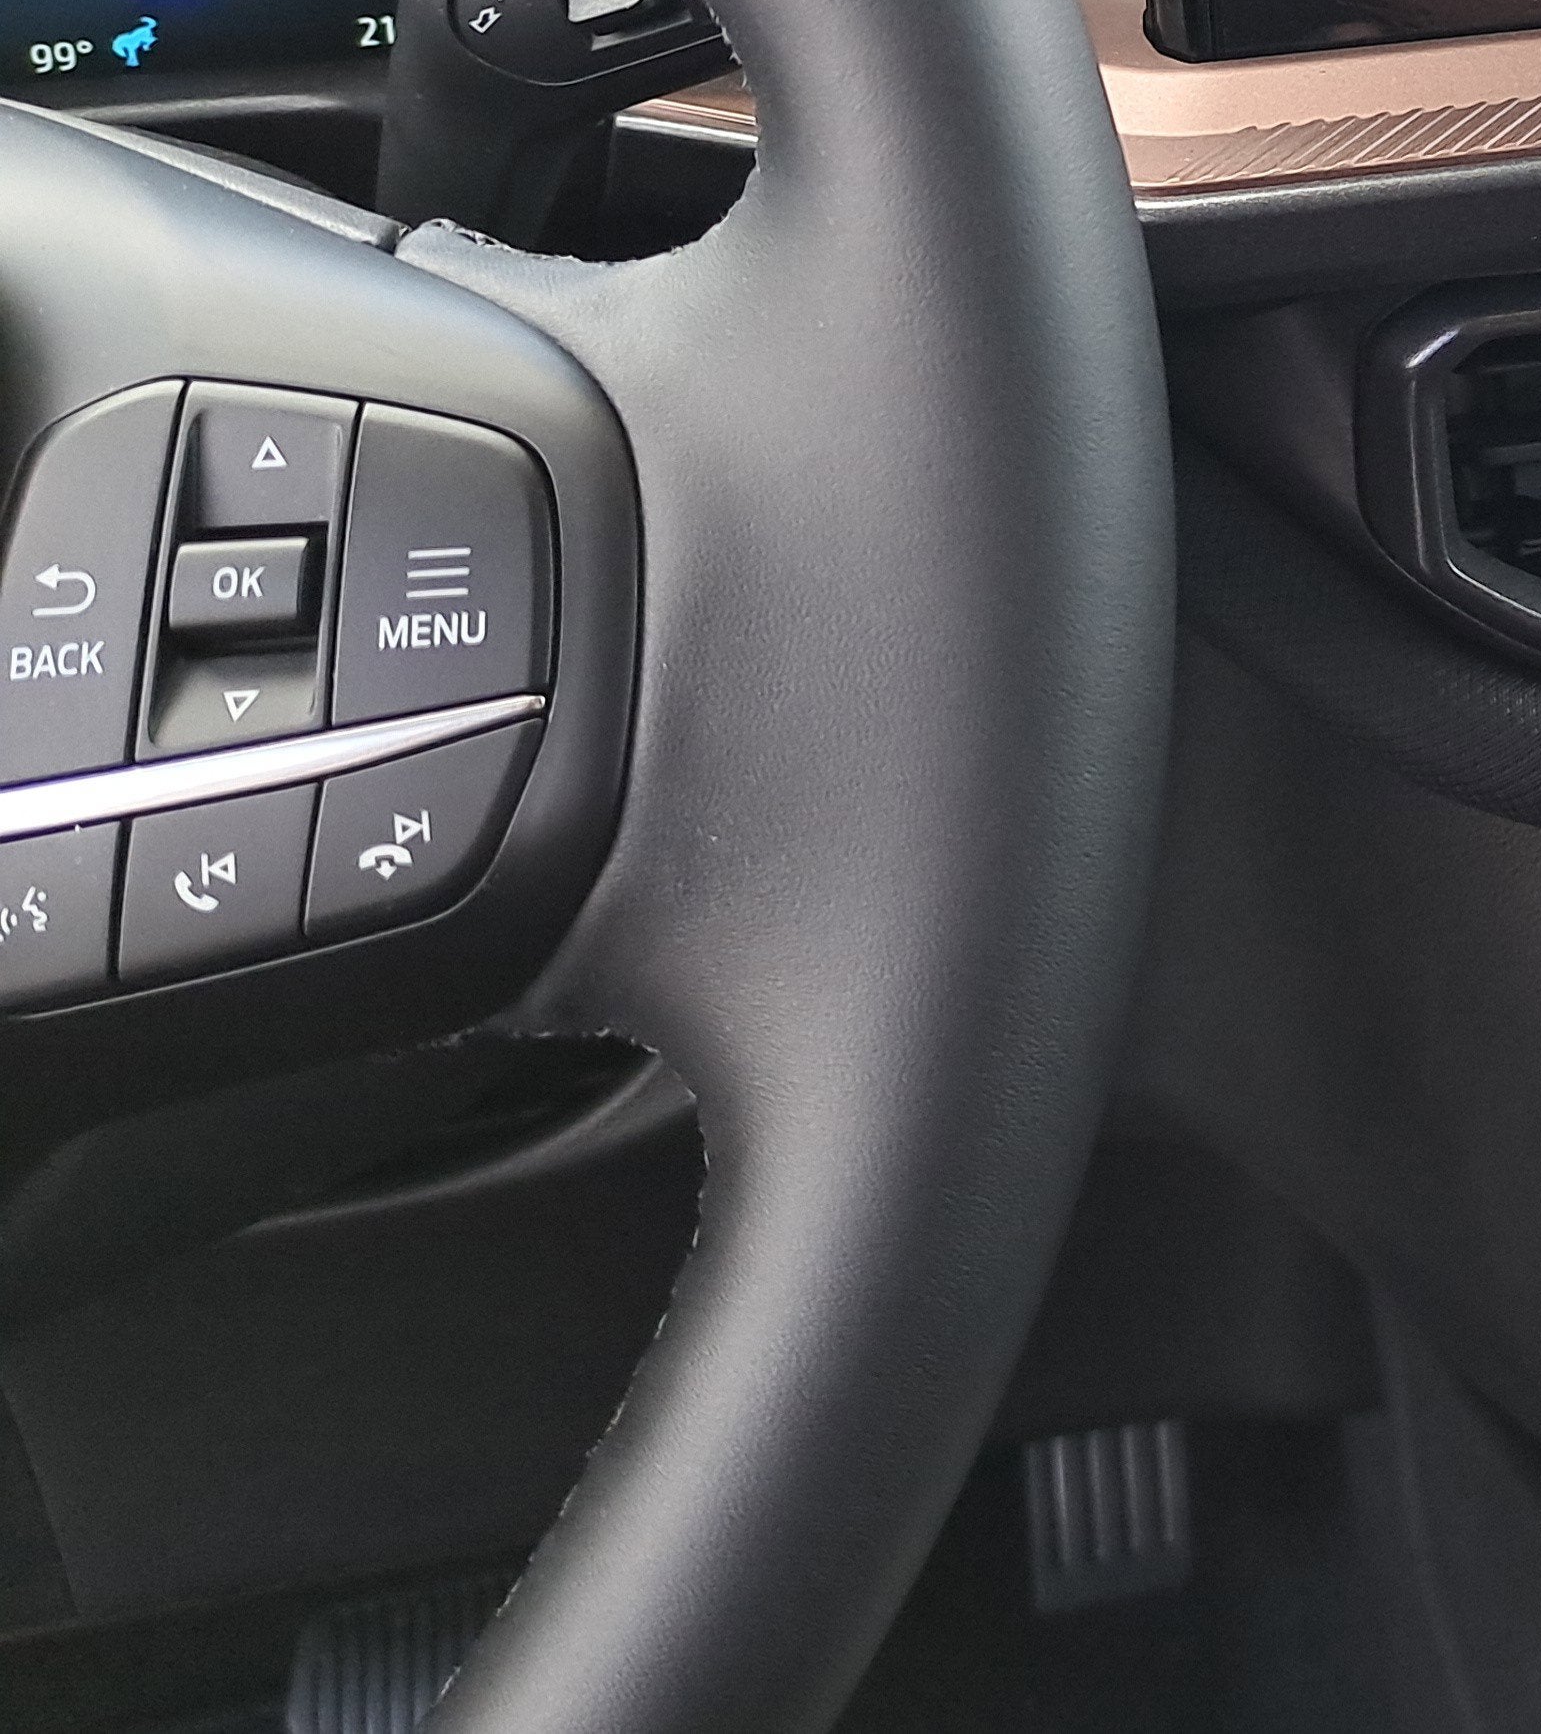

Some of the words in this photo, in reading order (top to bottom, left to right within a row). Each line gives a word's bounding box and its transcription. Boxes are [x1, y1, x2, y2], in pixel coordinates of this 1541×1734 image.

[30, 41, 94, 72] 99°
[212, 566, 264, 599] OK
[377, 611, 486, 651] MENU
[10, 641, 104, 680] BACK
